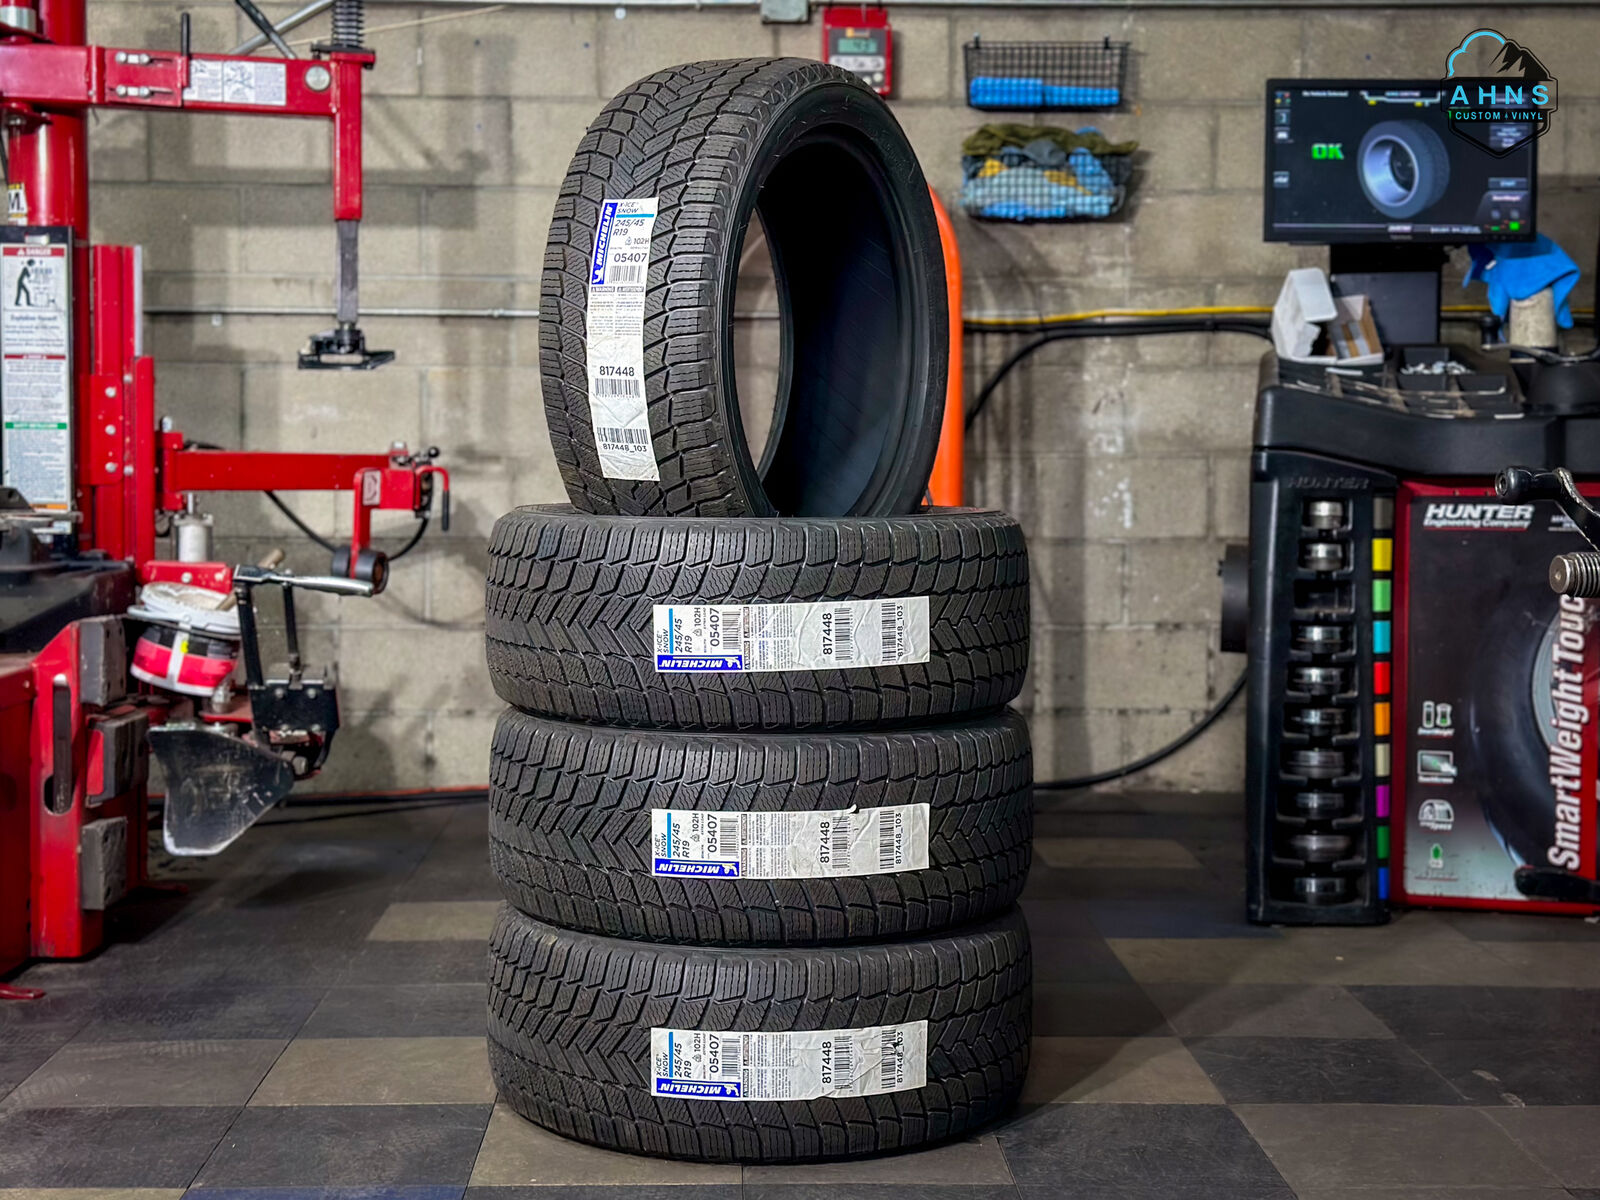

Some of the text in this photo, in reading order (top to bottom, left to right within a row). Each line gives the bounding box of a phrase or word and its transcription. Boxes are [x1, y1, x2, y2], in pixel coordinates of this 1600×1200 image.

[1311, 143, 1344, 160] OK
[596, 204, 613, 265] MICHELIN
[612, 228, 628, 236] R19
[614, 219, 645, 227] 245/45
[614, 253, 648, 263] 05407
[599, 365, 635, 377] 817448
[1423, 519, 1531, 529] Engineering Company
[1426, 504, 1535, 519] HUNTER
[675, 618, 683, 653] 245/45
[710, 608, 719, 646] 05407
[822, 613, 832, 654] 817448
[661, 660, 723, 668] MICHELIN
[1548, 594, 1588, 870] SmartWeight Touc
[673, 823, 681, 858] 245/45
[708, 814, 717, 852] 05407
[820, 822, 830, 863] 817448
[659, 864, 720, 874] MICHELIN
[675, 1043, 683, 1077] 245/45
[710, 1034, 719, 1073] 05407
[822, 1042, 832, 1084] 817448
[660, 1083, 721, 1094] MICHELIN
